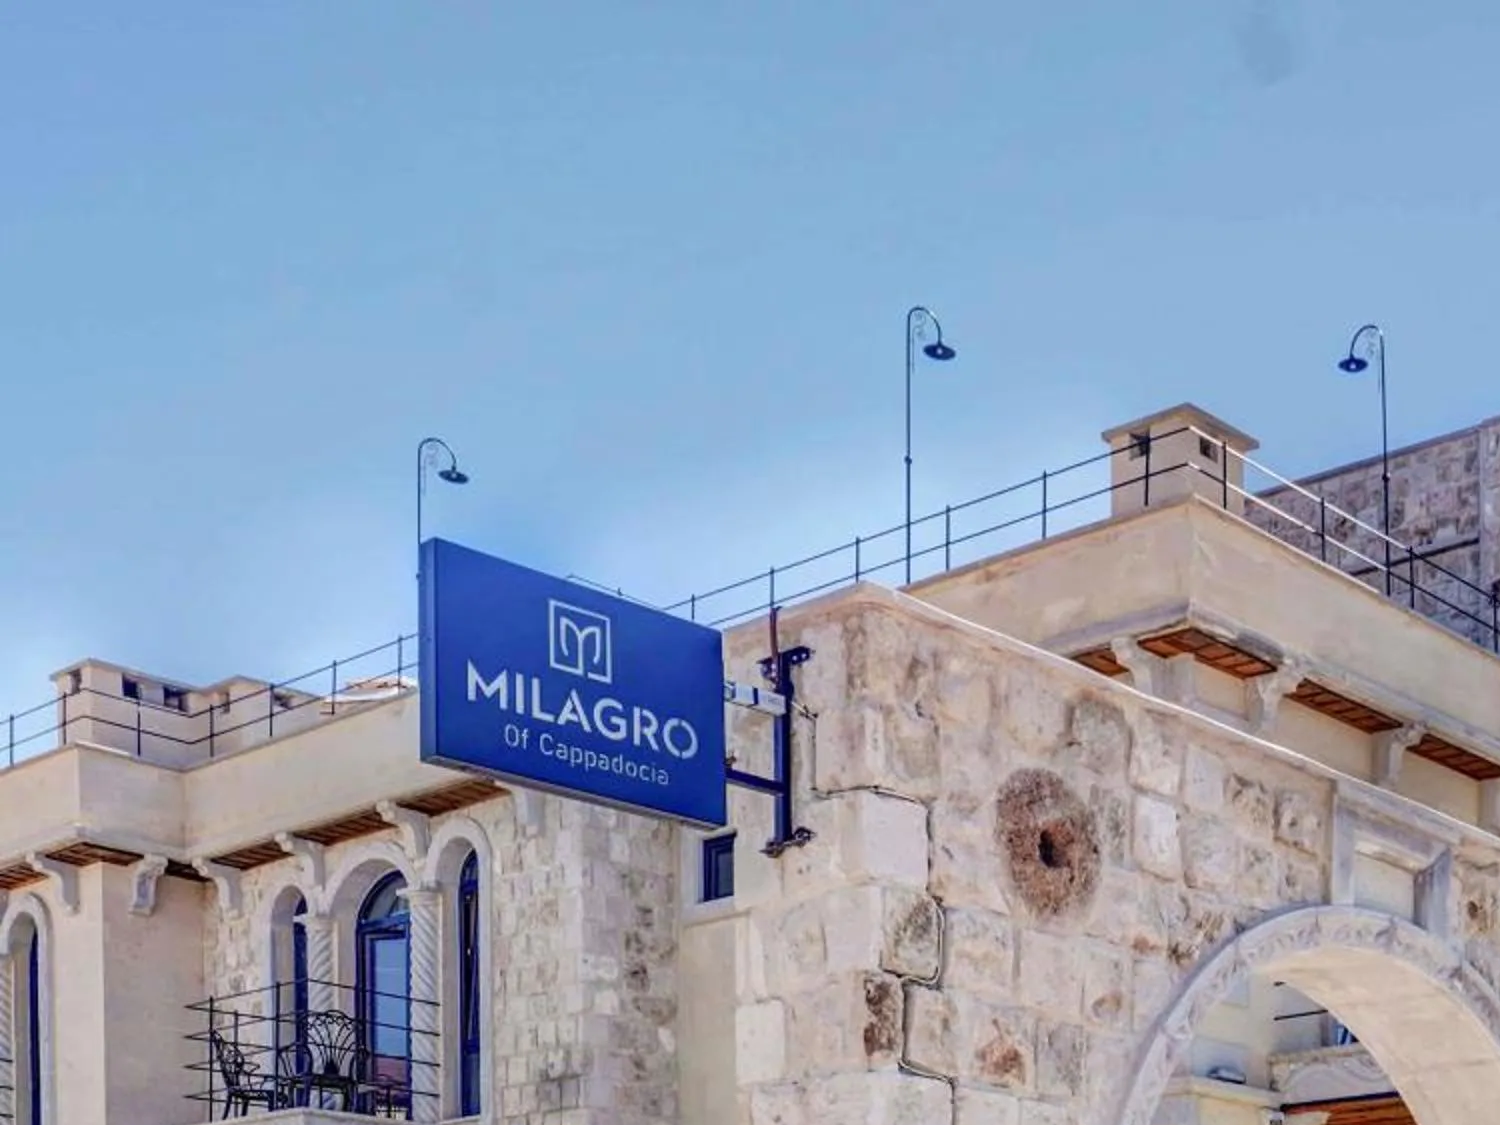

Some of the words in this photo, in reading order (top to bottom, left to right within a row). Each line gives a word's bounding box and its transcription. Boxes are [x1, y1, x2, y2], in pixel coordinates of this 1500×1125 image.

[467, 659, 698, 759] MILAGRO
[504, 724, 529, 750] Of
[539, 733, 670, 786] Cappadocia
